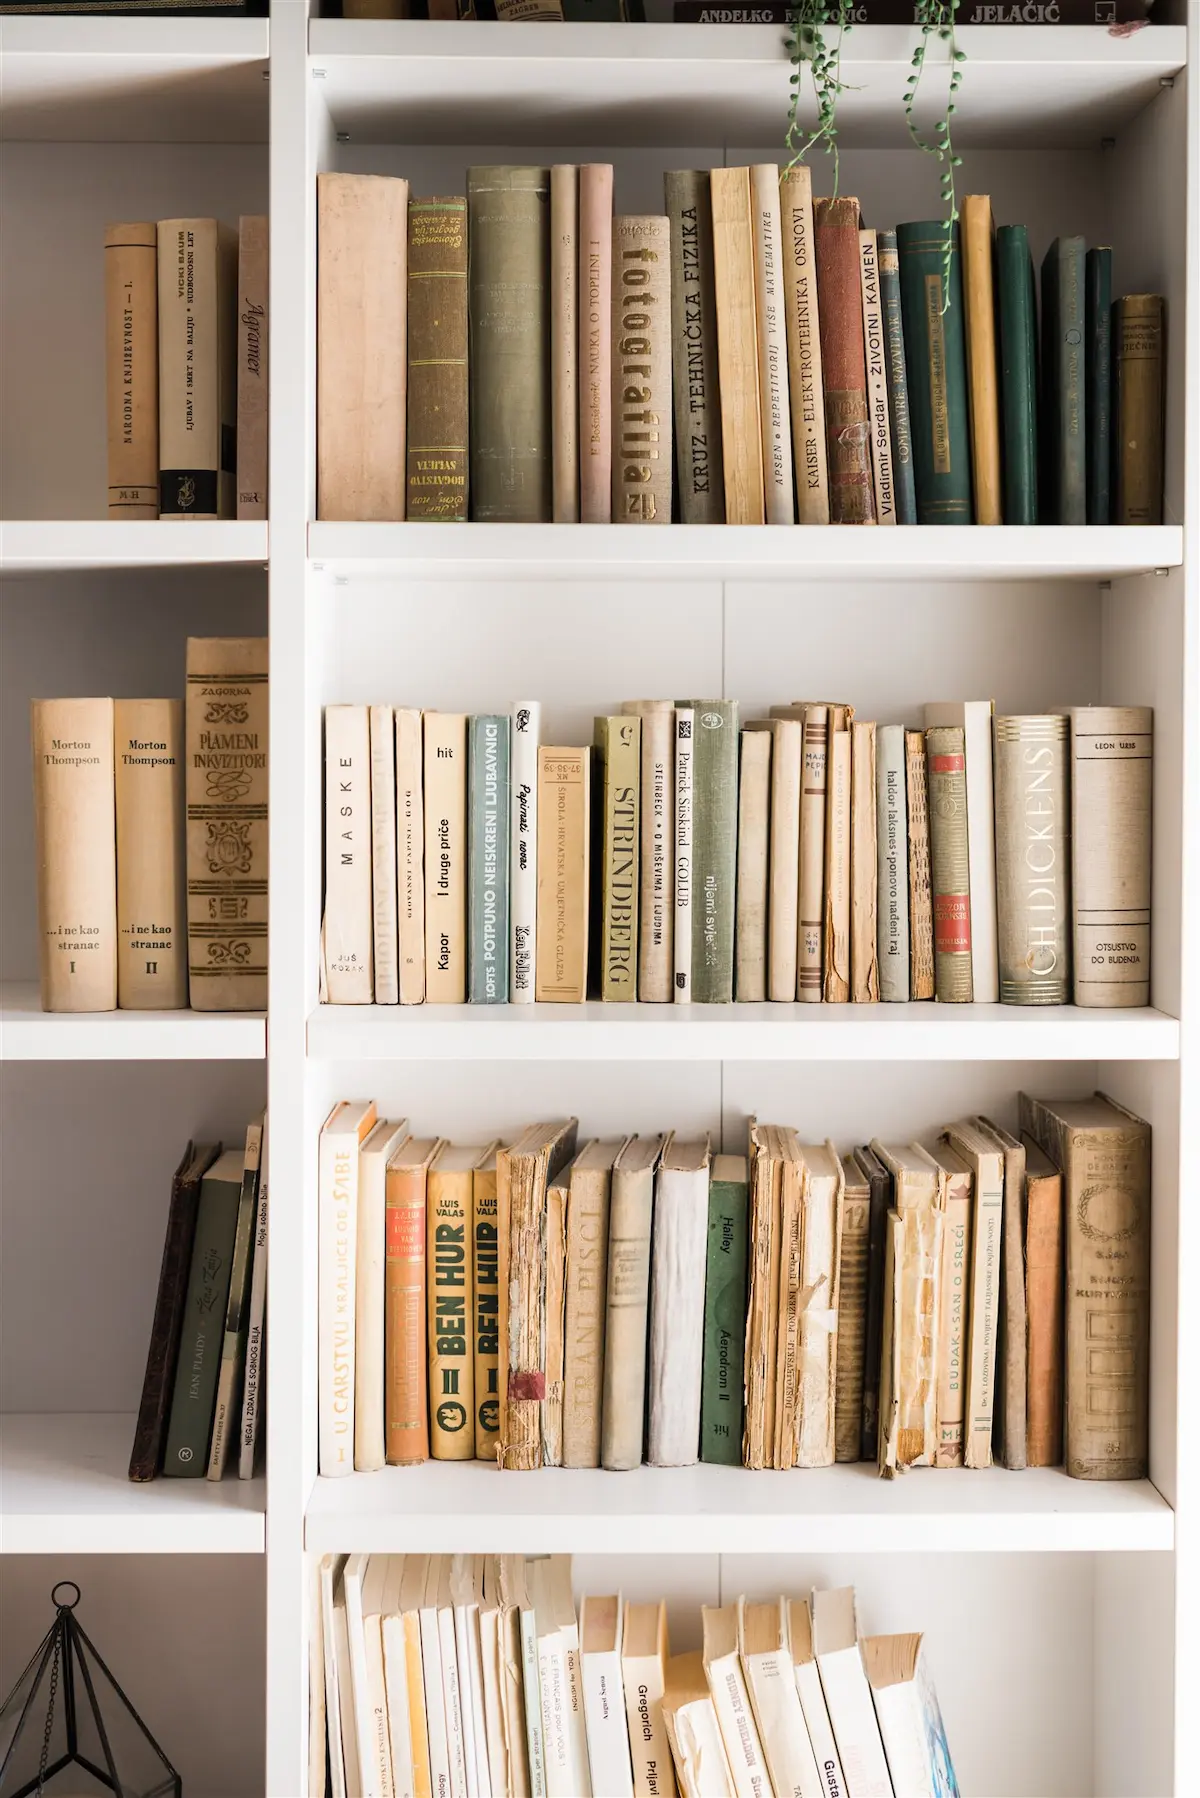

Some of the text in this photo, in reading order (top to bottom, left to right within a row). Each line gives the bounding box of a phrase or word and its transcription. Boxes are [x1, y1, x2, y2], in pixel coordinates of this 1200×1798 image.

[969, 0, 1060, 23] JELAČIĆ
[185, 231, 194, 248] LET
[186, 251, 194, 304] SUDBONOSNI
[588, 253, 600, 307] TOPLINI
[186, 316, 194, 346] BALIJU
[588, 312, 600, 323] O
[242, 297, 265, 378] Agramer
[588, 328, 601, 375] NAUKA
[681, 206, 710, 494] KRUZ TEHNIČKA FIZIKA
[761, 211, 784, 486] APSEN REPETITORIJ VIŠE MATEMATIKE
[792, 206, 820, 490] KAISER ELEKTROTEHNIKA OSNOVI
[186, 349, 194, 362] NA
[618, 247, 660, 483] fotografija
[123, 308, 133, 444] NARODNA KNJIŽEVNOST
[186, 365, 194, 388] SMRT
[864, 243, 893, 516] Vladimir Serdar ŽIVOTNI KAMEN
[186, 399, 194, 431] LJUBAV
[410, 476, 465, 486] BOGATSTVO
[201, 687, 252, 697] ZAGORKA
[52, 740, 91, 750] Morton
[128, 740, 167, 750] Morton
[199, 731, 259, 752] PLAMENI
[437, 747, 453, 758] hit
[1095, 742, 1115, 750] LEON
[44, 754, 100, 767] Thompson
[121, 754, 176, 767] Thompson
[193, 753, 267, 769] INKVIZITORI
[654, 763, 664, 817] STEINBECK
[340, 757, 353, 866] MASKE
[516, 783, 531, 871] Papirnati novac
[677, 752, 691, 908] Patrick Süskind GOLUB
[484, 723, 498, 999] LOFTS POTPUNO NEISKRENI LJUBAVNICI
[557, 826, 566, 877] HRVATSKA
[654, 844, 665, 892] MIŠEVIMA
[886, 770, 901, 956] haldor laksnes ponovo nađeni raj
[437, 818, 451, 971] Kapor druge priče
[609, 787, 635, 984] STRINDBERG
[704, 875, 717, 914] nijemi
[556, 880, 567, 942] UMJETNIČKA
[653, 904, 663, 946] LJUDIMA
[58, 942, 99, 950] stranac
[64, 926, 99, 935] ne kao
[131, 941, 172, 949] stranac
[136, 925, 172, 934] ne kao
[1096, 943, 1136, 951] OTSUSTVO
[70, 962, 76, 974] I
[146, 962, 158, 974] II
[515, 925, 530, 990] Ken Follett
[555, 944, 565, 982] GLAZBA
[1091, 956, 1104, 964] DO
[332, 1152, 350, 1205] SABE
[436, 1209, 464, 1218] VALAS
[440, 1200, 459, 1208] LUIS
[845, 1205, 865, 1230] 12
[257, 1202, 269, 1248] Moje sobno
[719, 1217, 734, 1254] Hailey
[336, 1238, 348, 1314] KRALJICE
[435, 1224, 466, 1356] BEN HUR
[573, 1212, 601, 1428] STRANI PISCI
[786, 1291, 797, 1333] PONIŽENI
[949, 1224, 964, 1391] BUDAK SAN O SREĆI
[251, 1325, 261, 1344] BILJA
[984, 1314, 992, 1347] POVIJEST
[193, 1331, 207, 1371] PLAIDY
[248, 1346, 259, 1380] SOBNOG
[333, 1321, 349, 1415] CARSTVU
[719, 1329, 731, 1388] Aerodrom
[189, 1373, 201, 1401] JEAN
[246, 1381, 257, 1416] ZDRAVLJE
[441, 1369, 460, 1394] II
[212, 1421, 225, 1466] SAFETY SERIES
[245, 1423, 255, 1447] NJEGA
[334, 1422, 349, 1436] U
[714, 1425, 729, 1437] hit
[374, 1707, 383, 1715] 2
[571, 1684, 579, 1712] ENGLISH
[601, 1697, 609, 1720] August
[725, 1673, 757, 1767] SIDNEY SHELDON
[638, 1684, 660, 1796] Gregorich Prljavi
